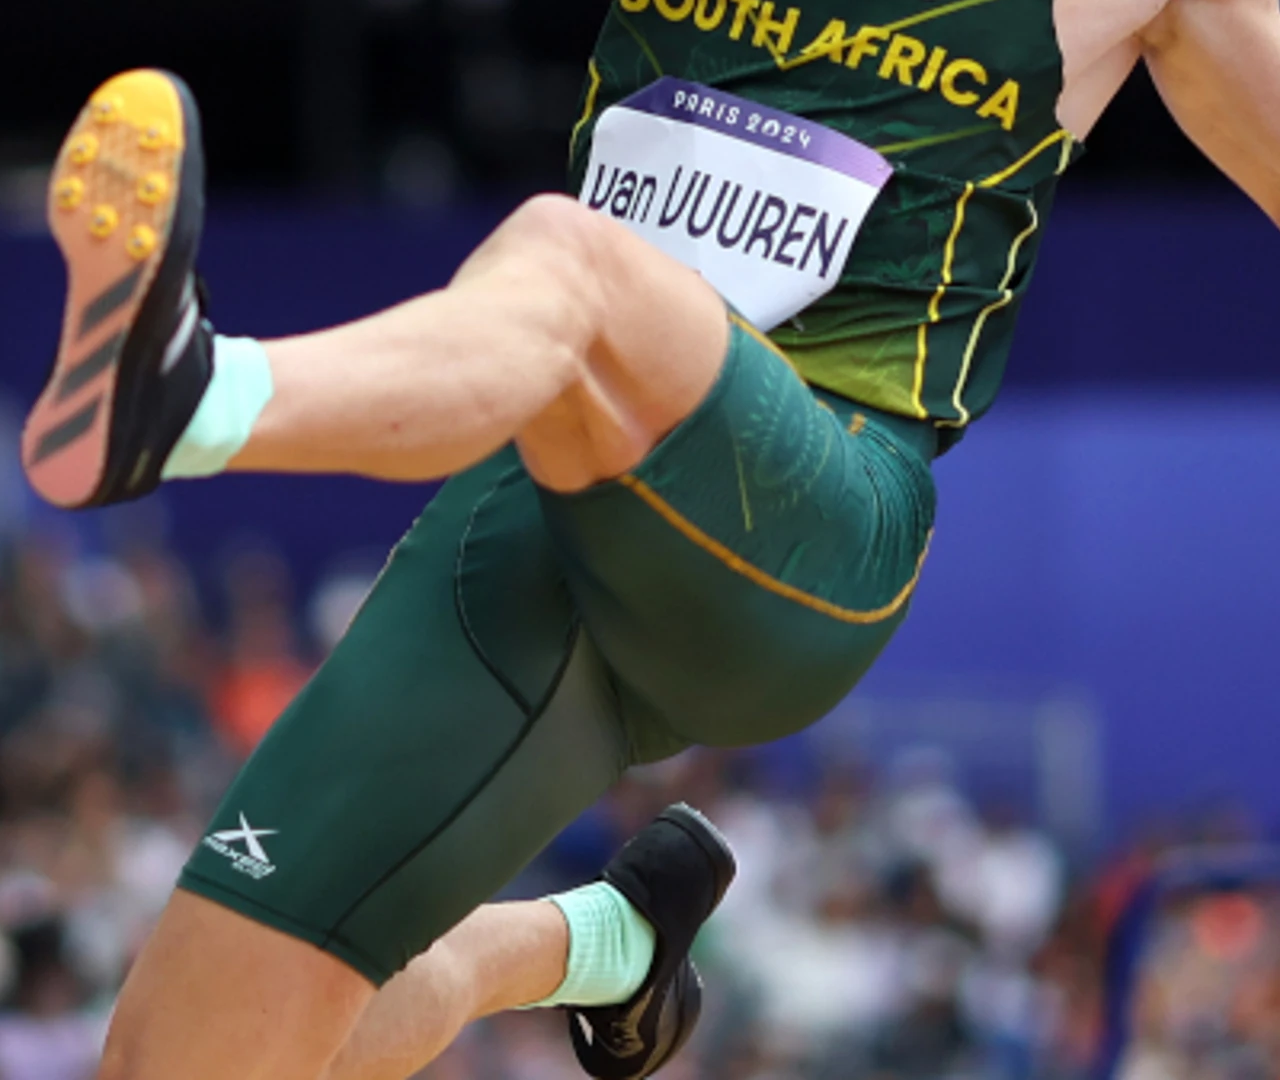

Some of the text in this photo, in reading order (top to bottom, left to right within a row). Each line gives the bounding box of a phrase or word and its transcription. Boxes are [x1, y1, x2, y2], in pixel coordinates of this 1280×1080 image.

[673, 90, 812, 149] PARIS 2024
[801, 18, 1020, 131] AFRICA
[588, 163, 849, 279] van VUUREN
